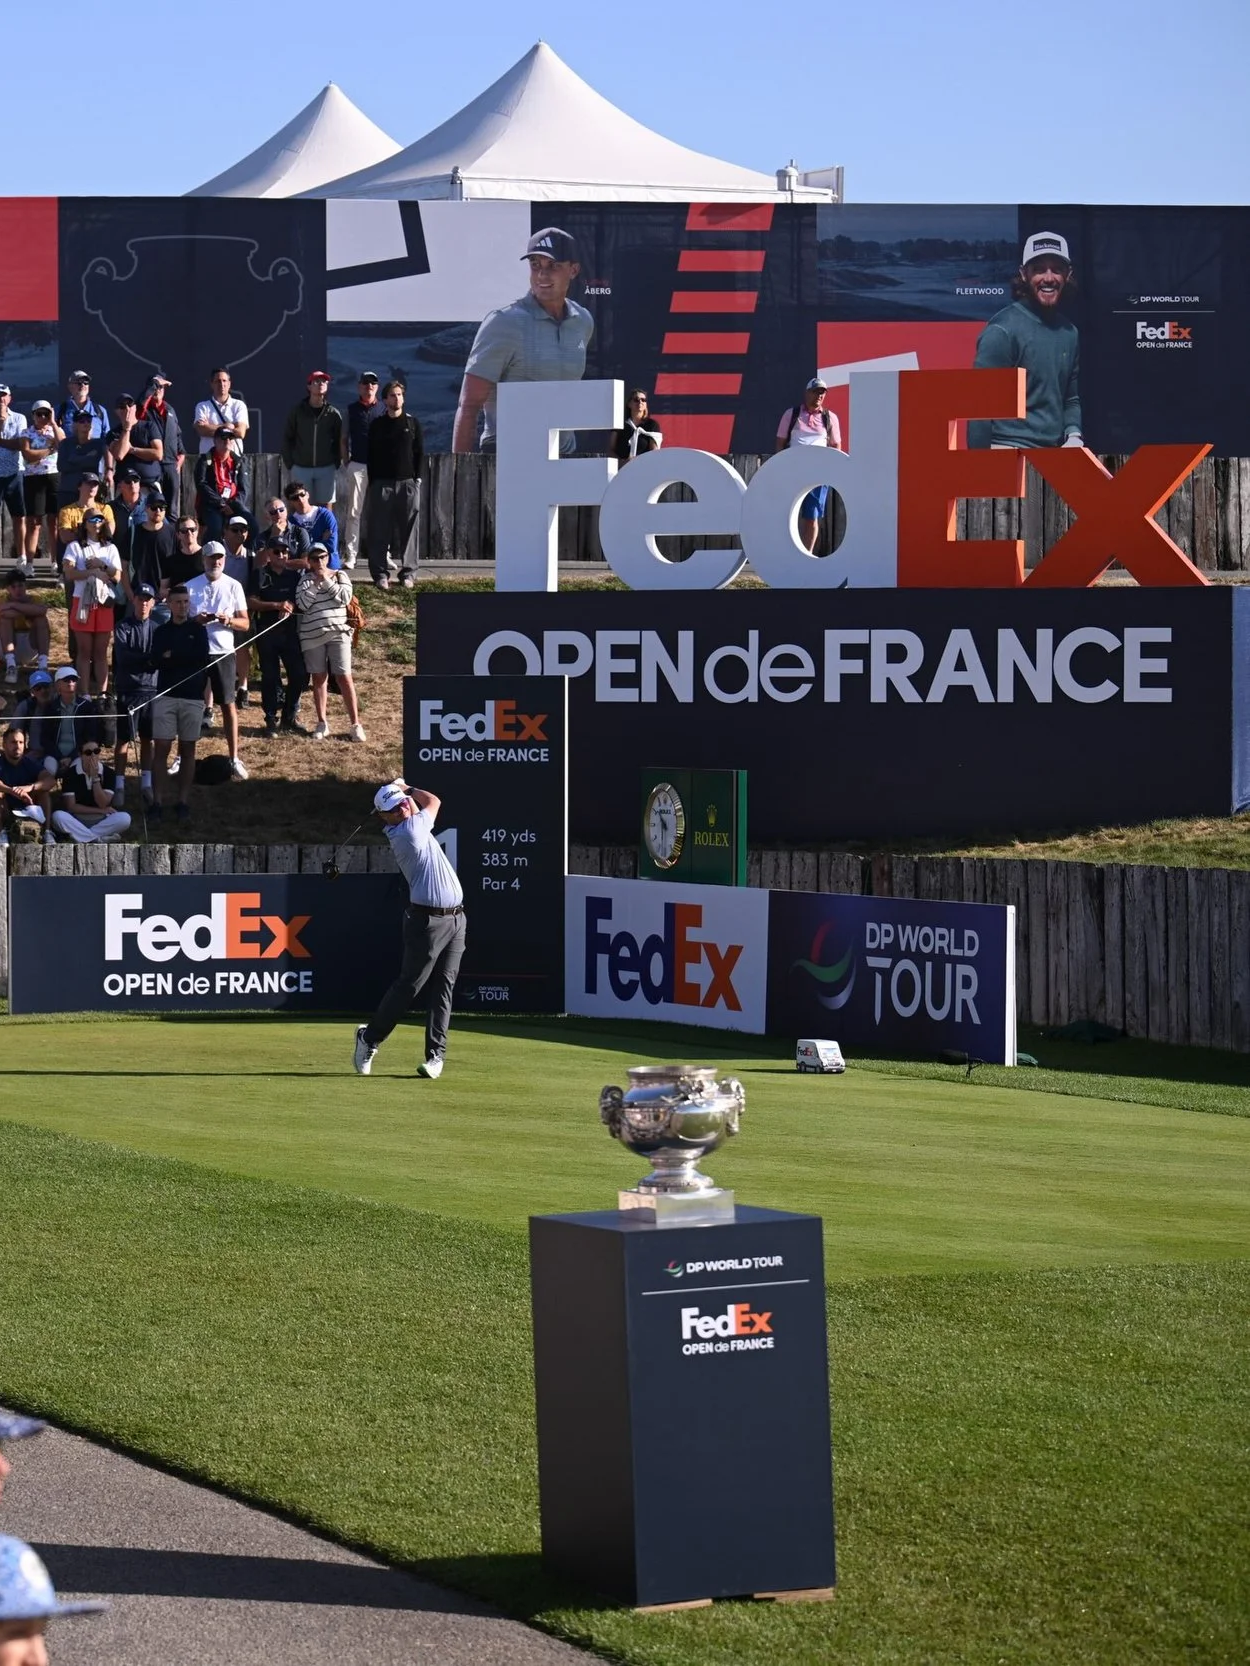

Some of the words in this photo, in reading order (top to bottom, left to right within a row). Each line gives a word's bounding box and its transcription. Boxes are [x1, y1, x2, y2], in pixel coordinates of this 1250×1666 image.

[584, 285, 611, 295] ÅBERG
[956, 287, 1004, 295] FLEETWOOD
[1136, 321, 1192, 340] FedEx
[495, 367, 1213, 592] FedEx
[704, 630, 816, 704] de
[824, 627, 1173, 703] FRANCE
[419, 700, 548, 742] FedEx
[419, 748, 461, 762] OPEN
[464, 748, 485, 762] de
[487, 748, 549, 762] FRANCE
[482, 829, 507, 843] 419
[511, 829, 536, 846] yds
[694, 832, 729, 846] ROLEX
[482, 853, 508, 866] 383
[514, 857, 528, 866] m
[482, 877, 507, 890] Par
[511, 878, 521, 890] 4
[104, 892, 312, 961] FedEx
[866, 922, 895, 950] DP
[898, 924, 980, 957] WORLD
[585, 896, 743, 1011] FedEx
[104, 973, 172, 996] OPEN
[178, 973, 210, 995] de
[215, 971, 313, 994] FRANCE
[866, 956, 981, 1026] TOUR
[479, 991, 510, 1001] TOUR
[798, 1047, 813, 1056] FedEx
[686, 1262, 704, 1273] DP
[705, 1259, 752, 1271] WORLD
[753, 1255, 783, 1269] TOUR
[681, 1303, 773, 1340] FedEx
[682, 1342, 713, 1355] OPEN
[714, 1340, 729, 1353] de
[730, 1337, 774, 1351] FRANCE
